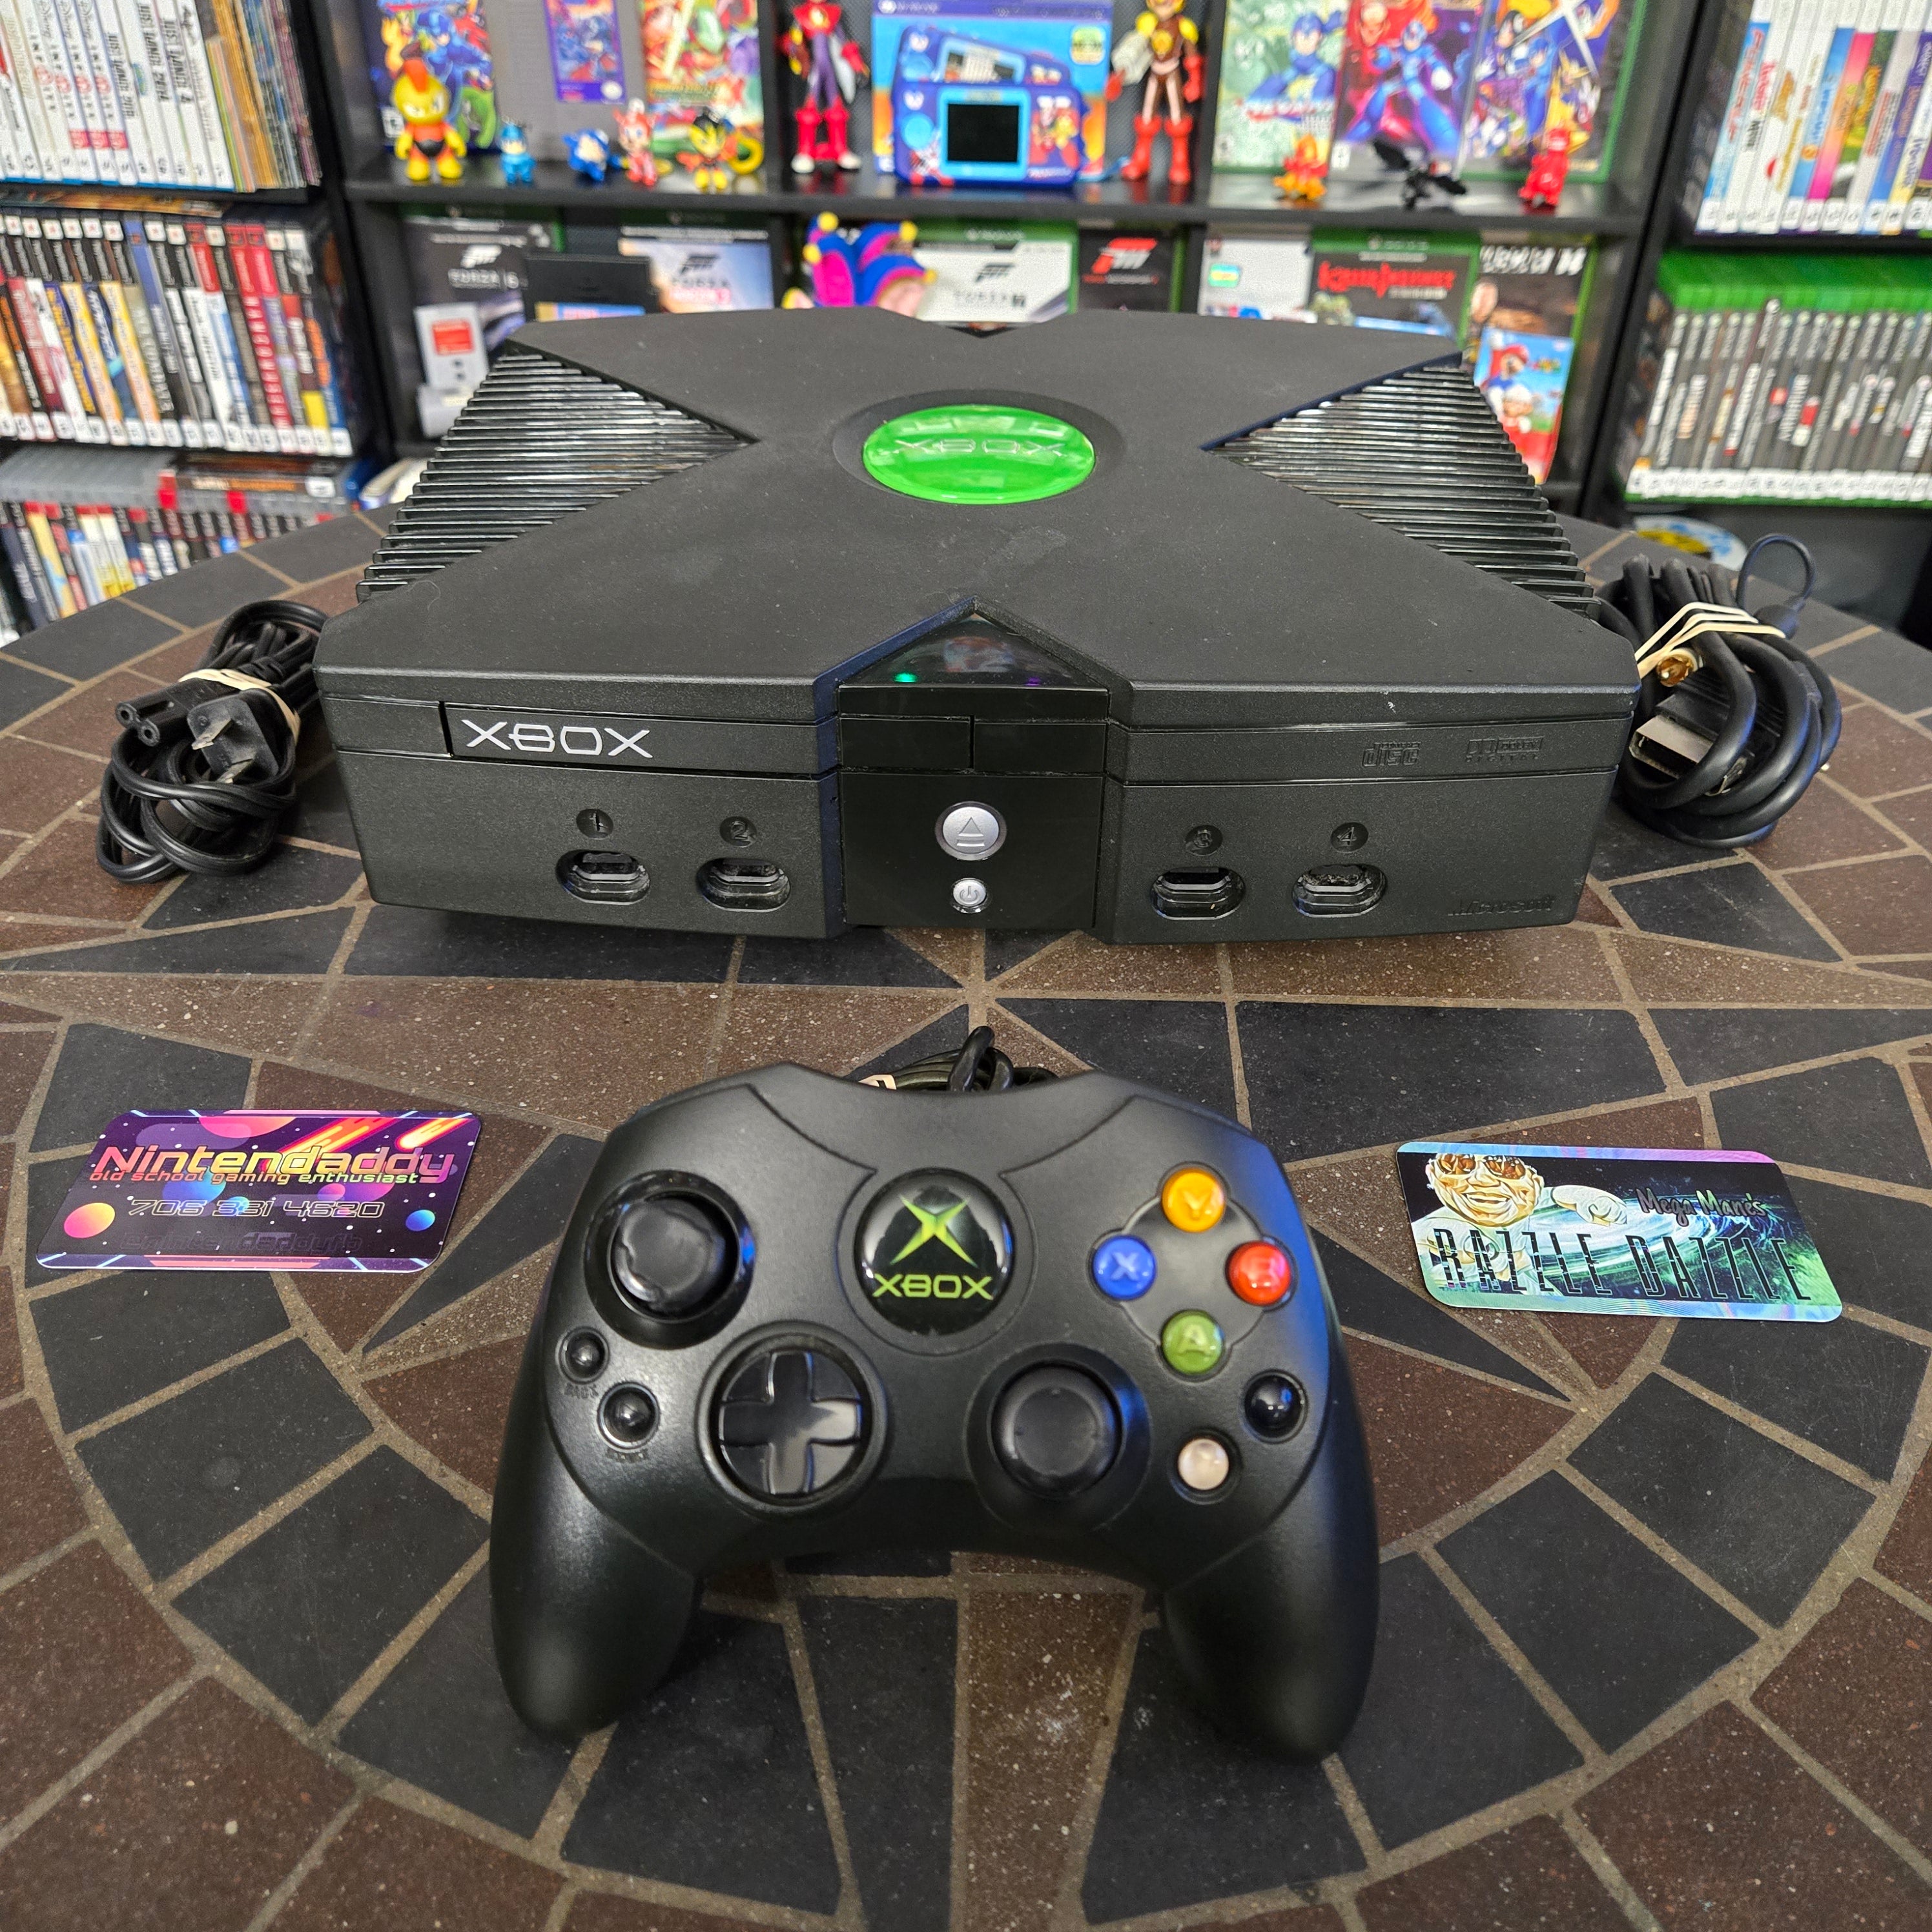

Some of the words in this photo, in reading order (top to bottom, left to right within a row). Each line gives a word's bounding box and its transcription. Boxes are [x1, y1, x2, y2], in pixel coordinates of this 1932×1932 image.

[892, 438, 1065, 457] XBOX
[460, 719, 653, 759] XBOX
[730, 820, 749, 841] 2
[1337, 827, 1356, 845] 4
[89, 1171, 123, 1183] old
[130, 1171, 204, 1183] school
[211, 1172, 293, 1186] gaming
[298, 1172, 419, 1184] enthusiast
[92, 1144, 455, 1184] Nintendaddy
[128, 1199, 207, 1217] 706
[283, 1200, 386, 1219] 4620
[1182, 1189, 1210, 1221] Y
[1636, 1187, 1698, 1227] Mega
[1111, 1251, 1140, 1282] X
[1432, 1227, 1614, 1297] RAZZLE
[1625, 1234, 1812, 1302] DAZZLE
[872, 1273, 994, 1300] XBOX
[1178, 1324, 1212, 1355] A
